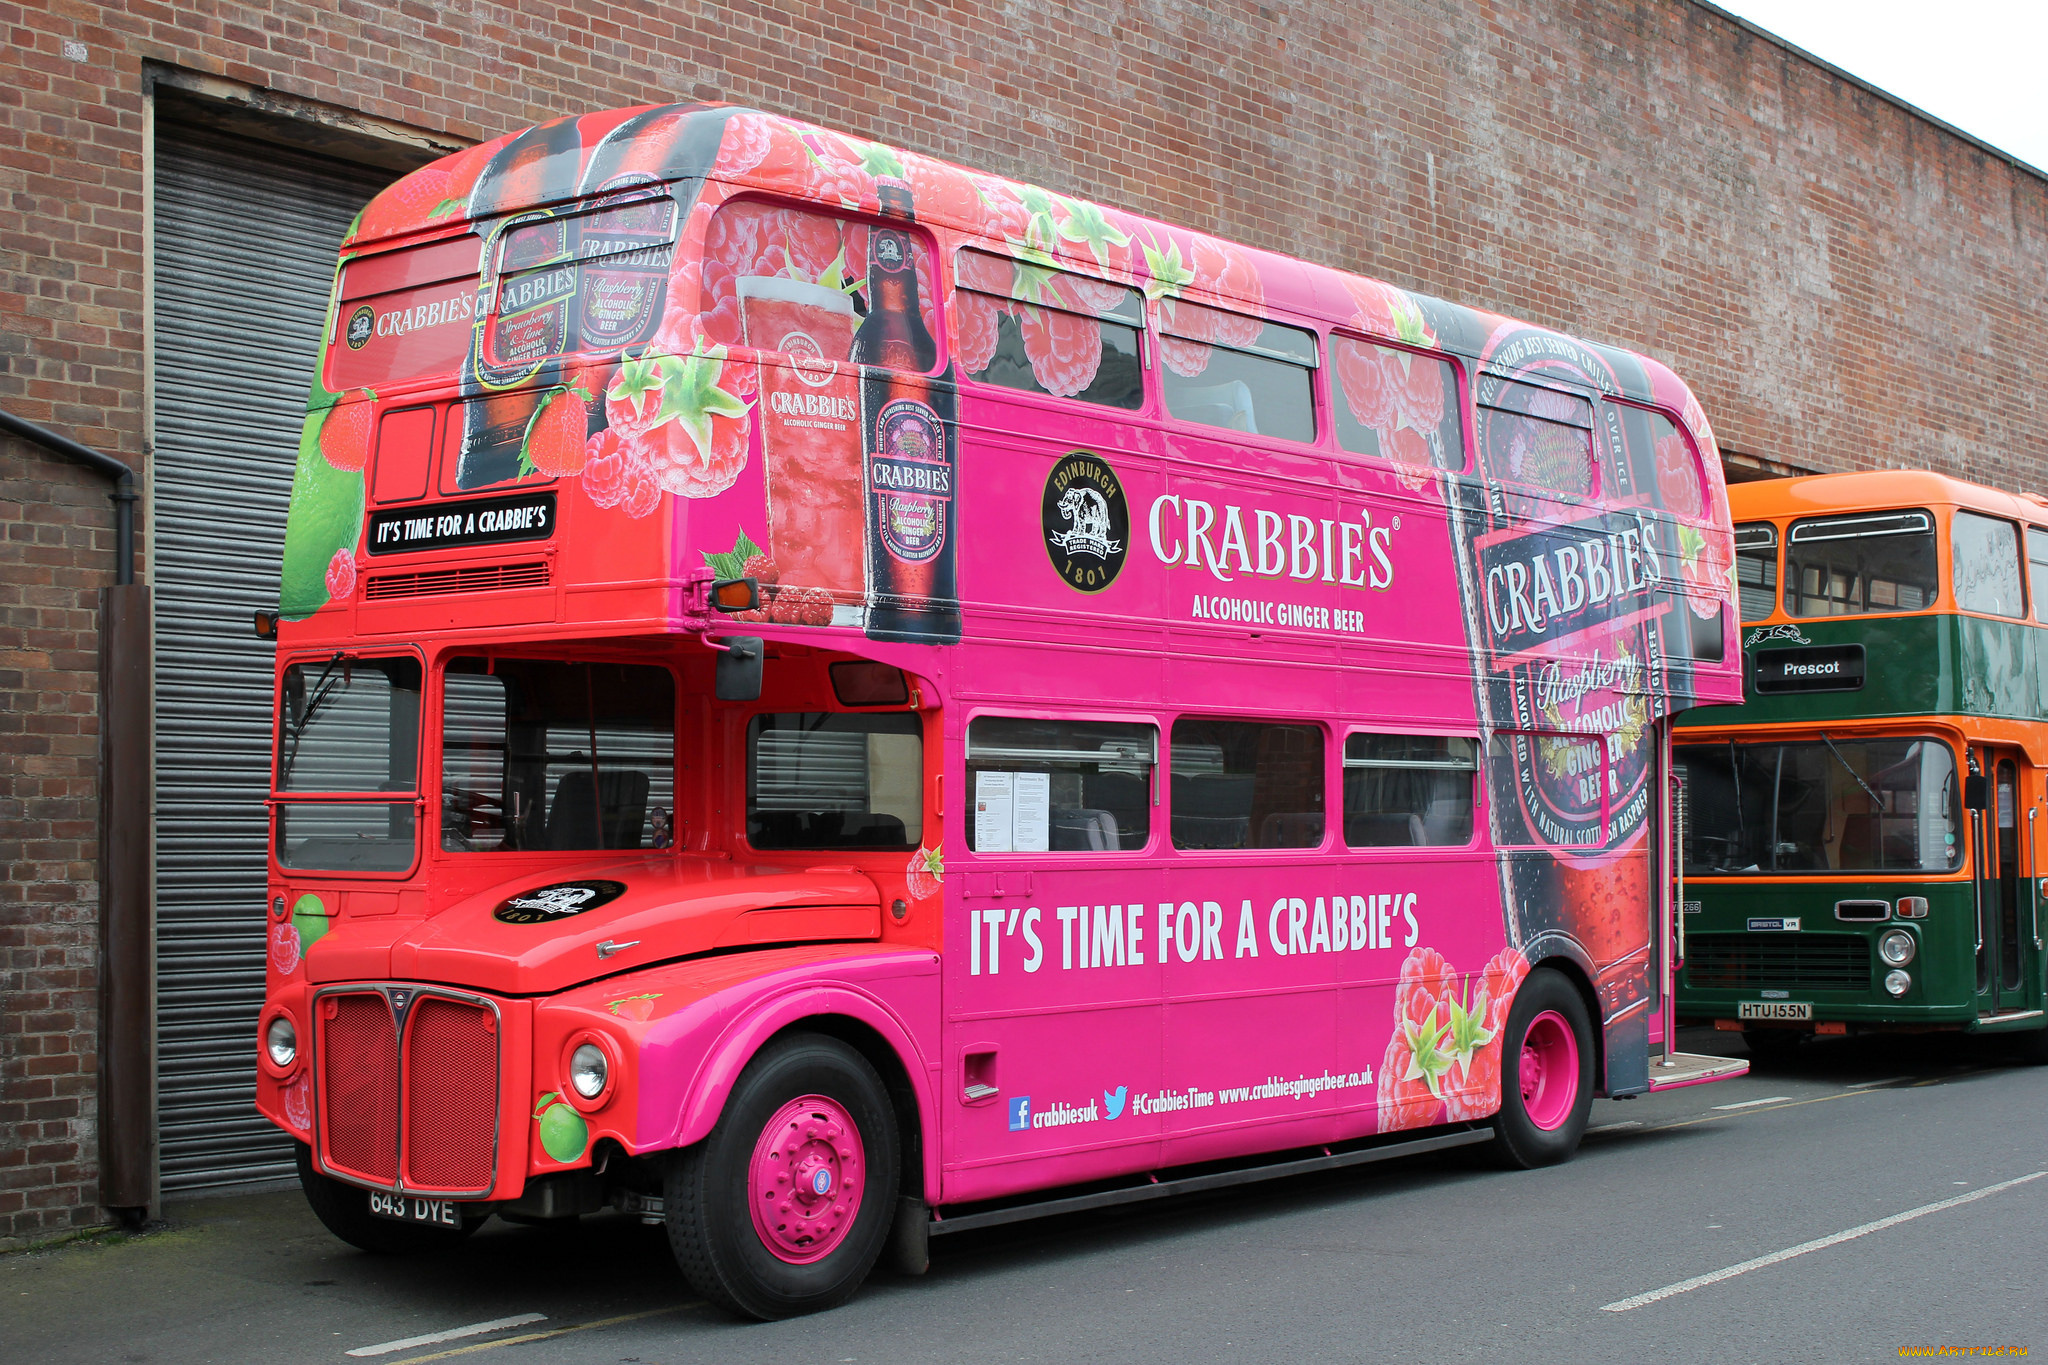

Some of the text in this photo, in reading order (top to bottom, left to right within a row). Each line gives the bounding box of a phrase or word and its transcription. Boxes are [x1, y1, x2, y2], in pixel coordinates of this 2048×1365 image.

[582, 238, 671, 268] CRABBIE'S
[591, 277, 644, 300] Raspberry
[376, 291, 473, 338] CRABBIE'S
[595, 298, 634, 311] ALCOHOLIC
[598, 309, 625, 321] GINGER
[501, 310, 554, 335] Strawberry
[599, 320, 618, 331] BEER
[509, 336, 546, 357] ALCOHOLIC
[531, 345, 548, 359] BEER
[784, 338, 817, 354] EDINBURGH
[803, 370, 825, 381] 1801
[771, 391, 857, 422] CRABBIE'S
[1523, 336, 1545, 356] BEST
[1545, 336, 1579, 363] SERVED
[1607, 411, 1622, 454] OVER
[1616, 461, 1628, 486] ICE
[783, 418, 847, 432] ALCOHOLIC GINGER BEER
[873, 463, 949, 493] CRABBIE'S
[1053, 461, 1117, 499] EDINBURGH
[888, 497, 935, 518] Raspberry
[377, 504, 547, 544] IT'S TIME FOR A CRABBIE'S
[895, 515, 929, 528] ALCOHOLIC
[901, 526, 925, 537] GINGER
[905, 536, 920, 546] BEER
[1069, 538, 1105, 551] TRADE MARK
[1069, 544, 1104, 556] REGISTERED
[1148, 494, 1394, 594] CRABBIE'S
[1064, 559, 1106, 586] 1801
[1487, 511, 1662, 634] CRABBIE'S
[1192, 594, 1365, 633] ALCOHOLIC GINGER BEER
[1537, 648, 1640, 714] Raspberry
[1784, 660, 1840, 676] Prescot
[1538, 812, 1574, 845] NATURAL
[1618, 783, 1648, 834] RASPBER
[1648, 630, 1661, 687] GINGER
[1567, 733, 1625, 777] GINGER
[1579, 768, 1619, 805] BEER
[500, 908, 544, 922] 1801
[970, 892, 1420, 976] IT'S TIME FOR A CRABBIE'S
[1742, 1003, 1807, 1018] HTU155N
[1132, 1064, 1374, 1116] #CrabbiesTime www.crabbiesgingerbeer.co.uk
[1032, 1099, 1099, 1129] crabbiesuk
[371, 1191, 455, 1225] 643 DYE
